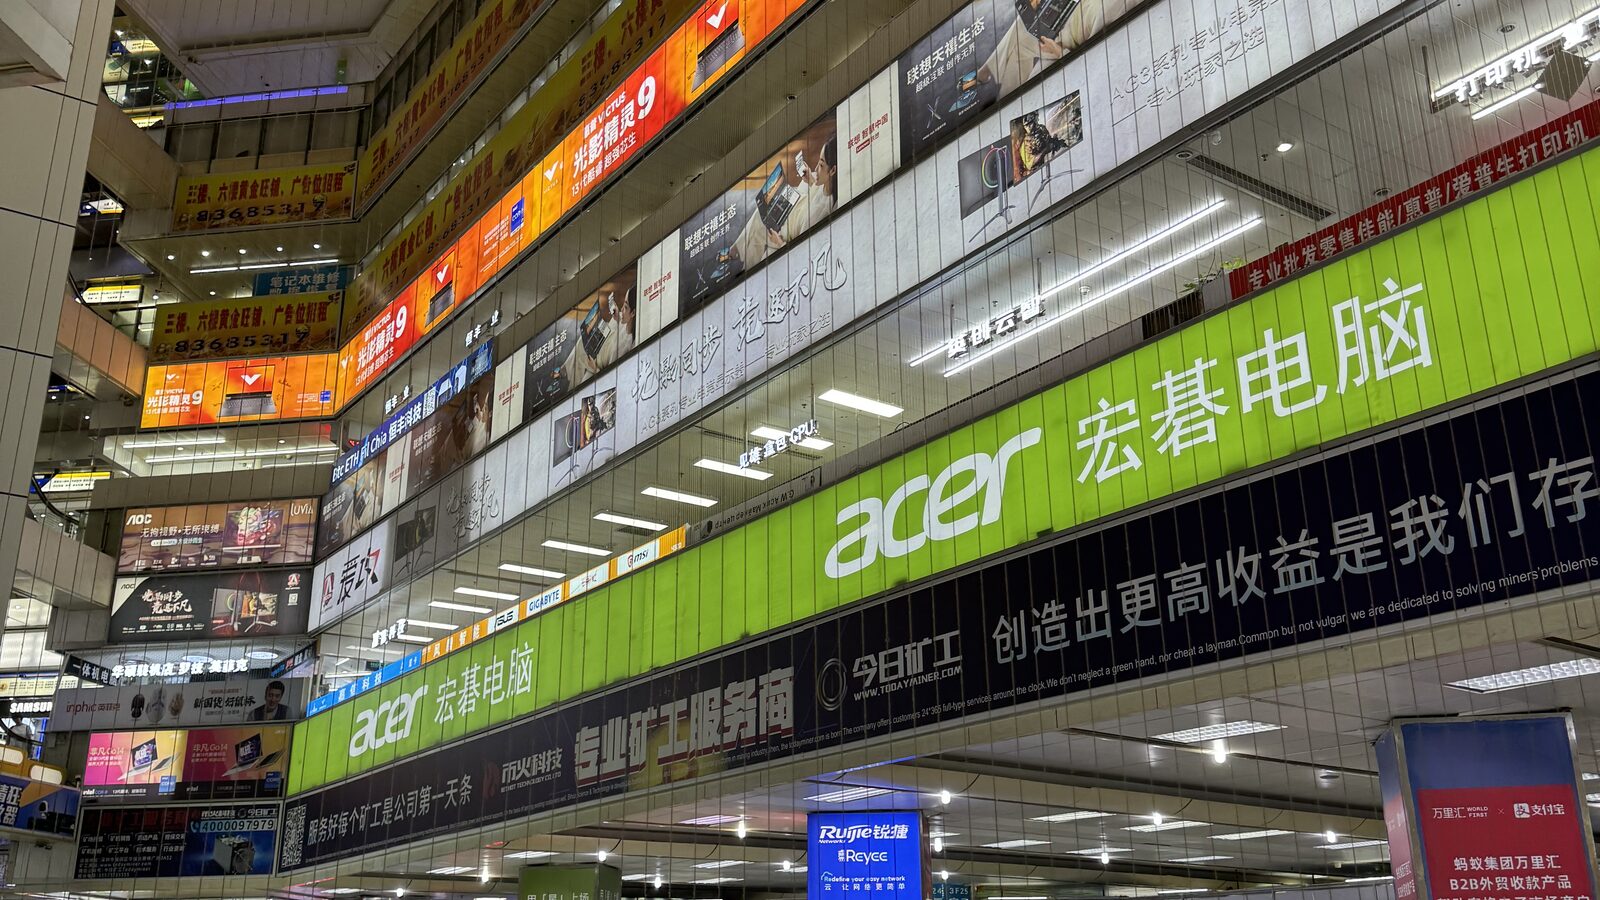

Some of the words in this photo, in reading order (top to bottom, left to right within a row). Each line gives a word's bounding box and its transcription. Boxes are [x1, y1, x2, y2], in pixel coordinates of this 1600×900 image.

[907, 16, 985, 86] 联想天禧生态
[915, 64, 945, 93] 超级互联
[946, 43, 976, 71] 创作无界
[1454, 45, 1541, 103] 打印机
[573, 75, 656, 179] 光影精灵9
[847, 132, 861, 150] 联想
[684, 203, 737, 252] 联想天禧生态
[1248, 119, 1589, 291] 专业批发零售佳能/惠普/爱普生打印机
[1076, 277, 1433, 484] 宏碁电脑
[332, 465, 344, 483] Btc
[345, 452, 360, 472] ETH
[370, 432, 388, 453] Chia
[126, 514, 152, 526] AOC
[824, 426, 1042, 579] acer
[634, 550, 649, 563] msi
[494, 611, 514, 628] ASUS
[528, 589, 560, 612] GIGABYTE
[852, 629, 963, 688] 今日矿工
[1016, 684, 1026, 694] the
[1077, 666, 1104, 683] neglect
[1112, 661, 1133, 675] green
[1158, 652, 1171, 663] nor
[1173, 646, 1196, 659] cheat
[1298, 619, 1314, 632] not
[1350, 609, 1365, 621] we
[1368, 605, 1385, 617] are
[1387, 590, 1439, 612] dedicated
[1442, 588, 1452, 600] to
[434, 641, 534, 724] 宏碁电脑
[349, 684, 429, 758] acer
[575, 666, 795, 778] 专业矿工服务商
[202, 819, 274, 831] 4000097979
[307, 774, 473, 846] 服务好每个矿工是公司第一天条
[819, 824, 873, 843] Ruijie
[873, 824, 909, 840] 锐捷
[1432, 806, 1467, 820] 万里汇
[1531, 803, 1565, 816] 支付宝
[846, 849, 888, 865] Reyee
[1454, 855, 1562, 872] 蚂蚁集团万里汇
[1450, 876, 1572, 891] B2B外贸收款产品
